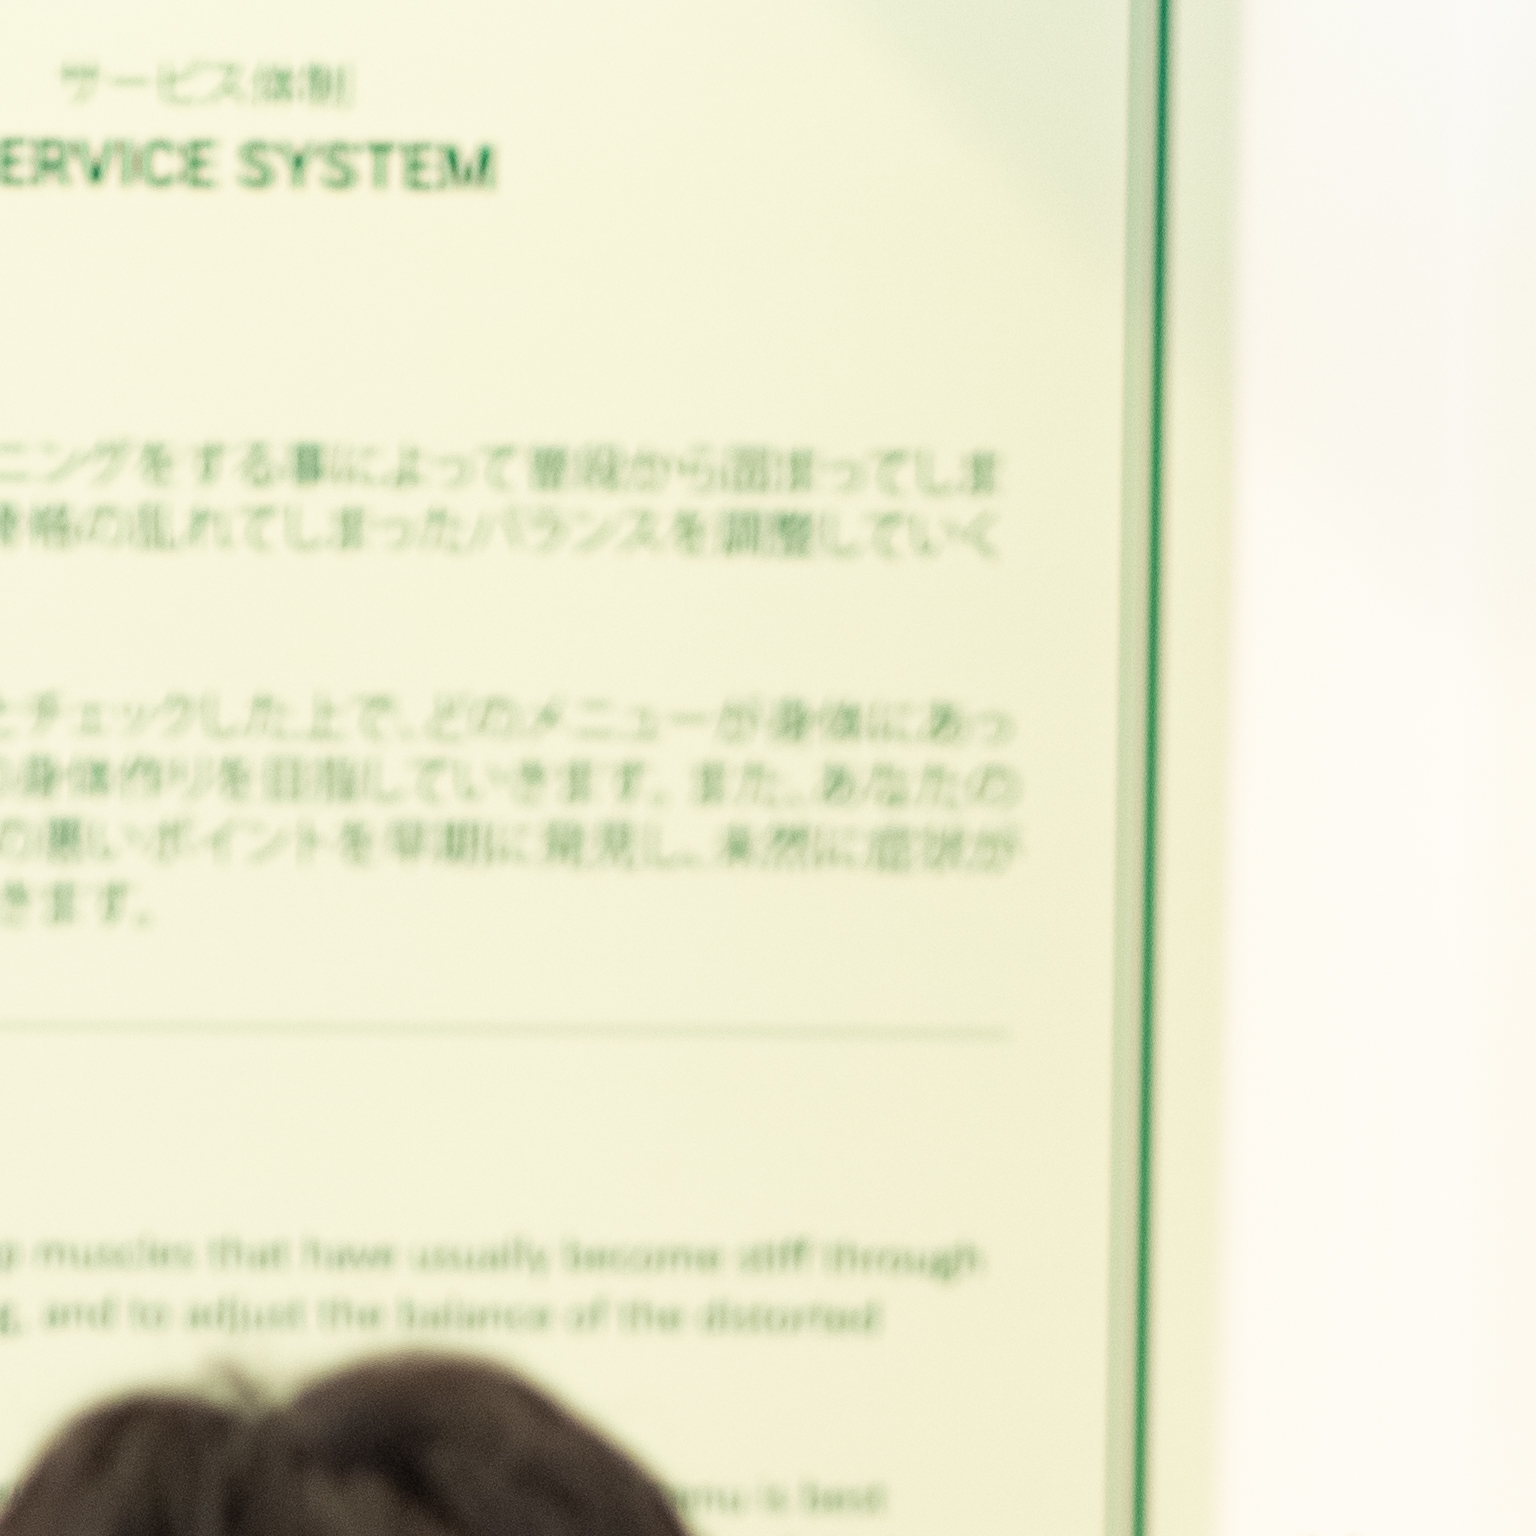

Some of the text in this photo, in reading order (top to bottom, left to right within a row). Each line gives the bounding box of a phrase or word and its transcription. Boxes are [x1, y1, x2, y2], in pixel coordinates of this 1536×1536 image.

[58, 61, 356, 107] サービス体制
[239, 136, 500, 194] SYSTEM
[32, 1236, 196, 1270] muscles
[206, 1236, 291, 1272] that
[301, 1237, 399, 1272] have
[409, 1236, 552, 1277] usually
[560, 1239, 725, 1275] become
[737, 1238, 810, 1275] stiff
[819, 1239, 987, 1284] through
[40, 1296, 121, 1331] and
[128, 1298, 173, 1331] to
[182, 1296, 306, 1337] adjust
[316, 1297, 387, 1331] the
[395, 1298, 555, 1333] balance
[565, 1299, 612, 1334] of
[617, 1299, 684, 1335] the
[697, 1300, 885, 1338] distorted
[800, 1480, 888, 1516] best
